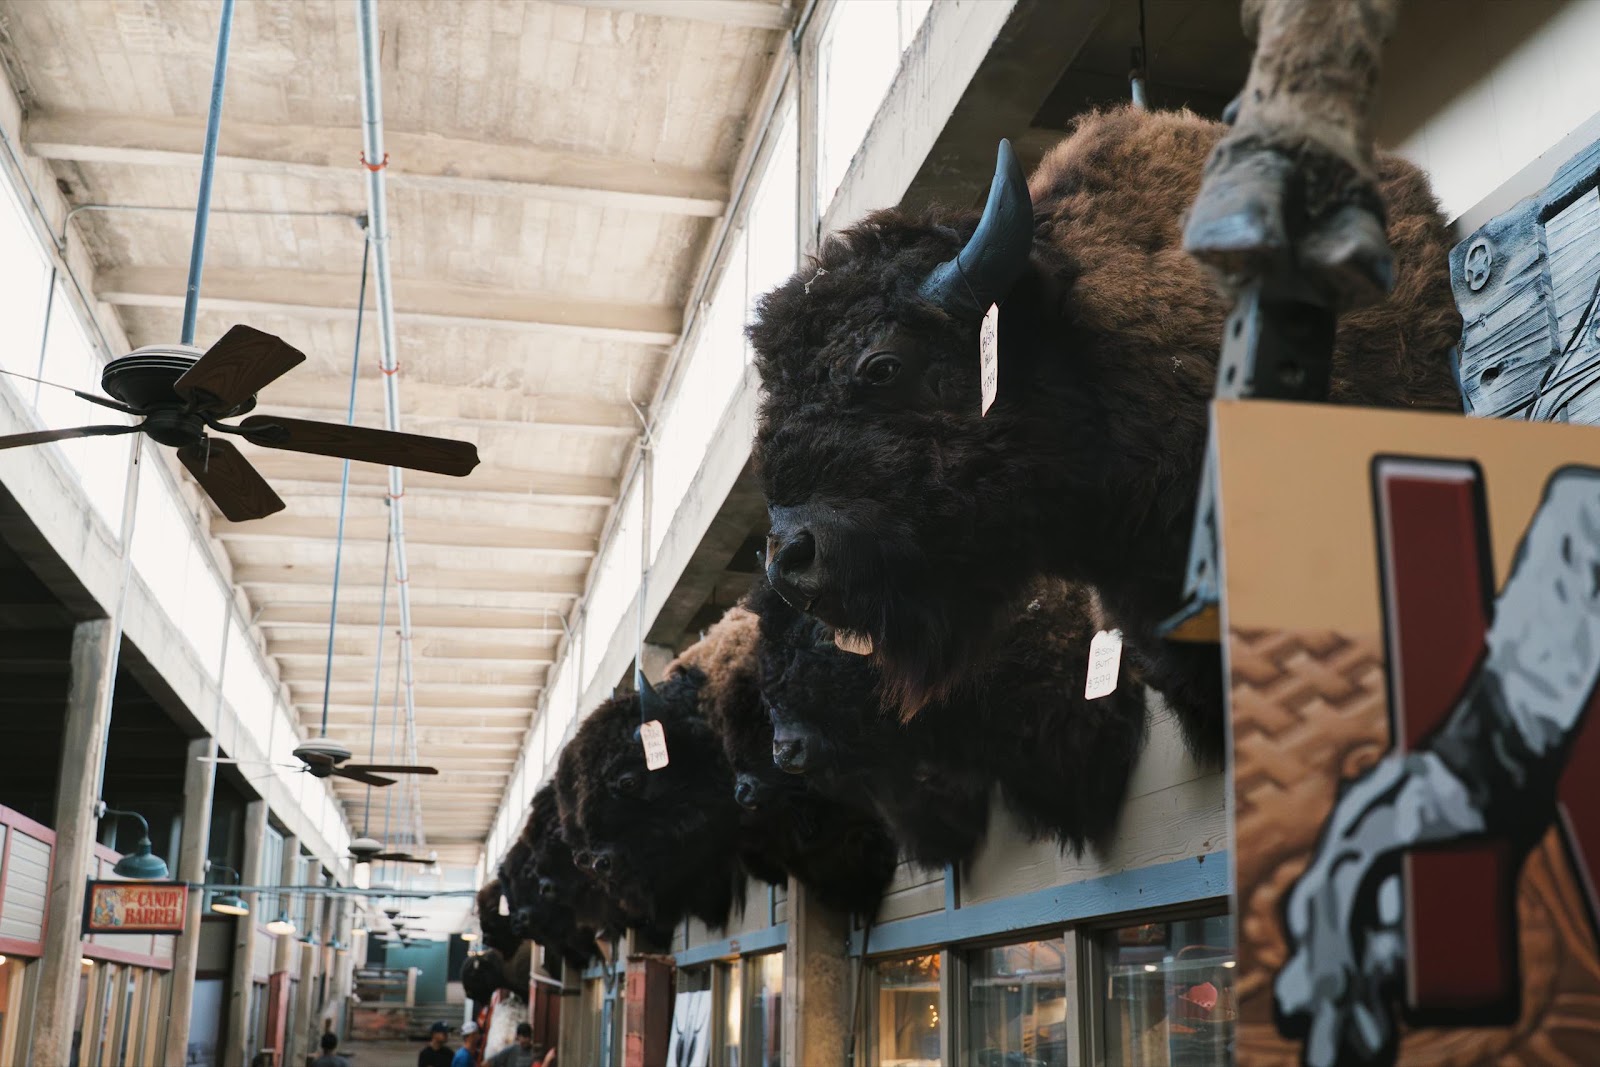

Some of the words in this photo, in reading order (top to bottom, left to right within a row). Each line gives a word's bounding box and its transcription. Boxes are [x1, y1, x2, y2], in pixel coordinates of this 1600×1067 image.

[1095, 657, 1113, 670] BUTT
[1088, 673, 1111, 690] $399
[137, 890, 181, 907] CANDY
[124, 907, 178, 925] BARREL
